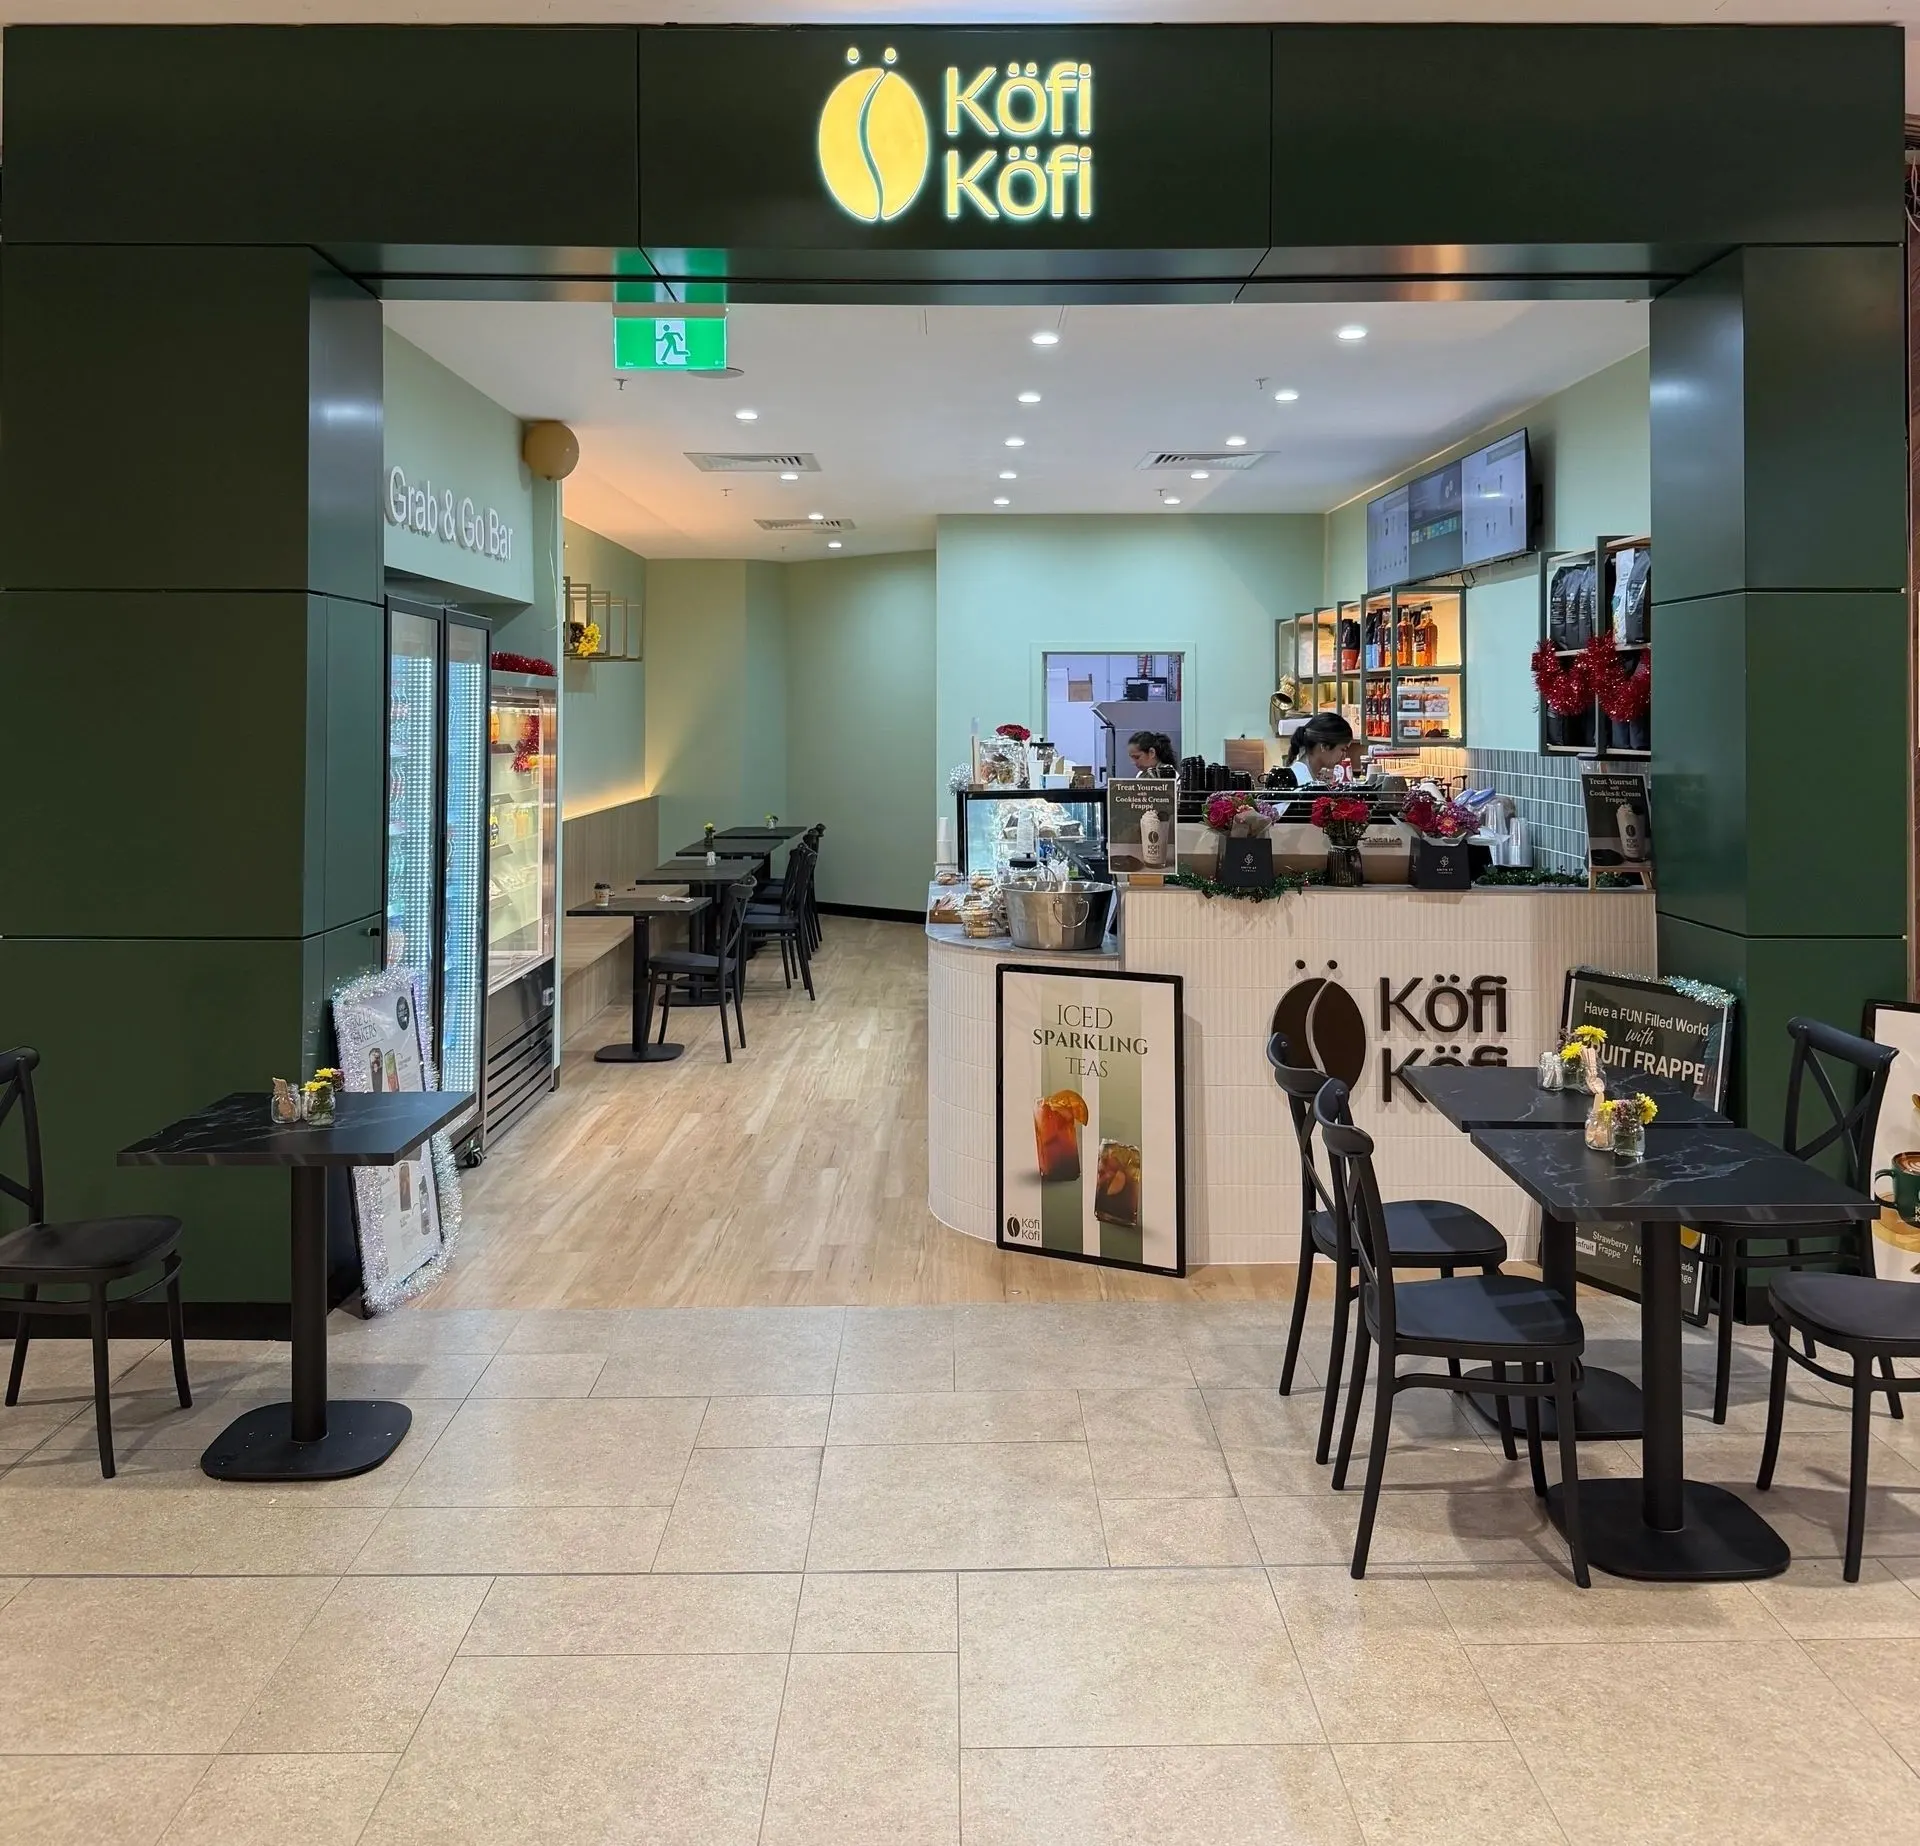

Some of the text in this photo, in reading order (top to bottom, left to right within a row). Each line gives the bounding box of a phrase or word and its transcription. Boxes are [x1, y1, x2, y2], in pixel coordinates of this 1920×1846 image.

[946, 62, 1092, 134] Köfi
[946, 145, 1092, 218] Köfi
[389, 465, 514, 561] Grab & Go Bar
[1115, 783, 1168, 792] Treat Yourself
[1148, 796, 1170, 804] Cream
[1379, 973, 1508, 1033] Köfi
[1057, 1004, 1113, 1030] ICED
[1584, 1000, 1709, 1038] Have a FUN Filled World
[1032, 1028, 1149, 1055] SPARKLING
[1625, 1026, 1655, 1048] with
[1065, 1056, 1109, 1078] TEAS
[1592, 1041, 1706, 1086] RUIT FRAPPE
[1021, 1217, 1040, 1230] Köfi
[1021, 1229, 1040, 1241] Köfi
[1592, 1230, 1630, 1253] Strawberry
[1597, 1243, 1622, 1260] Frappe
